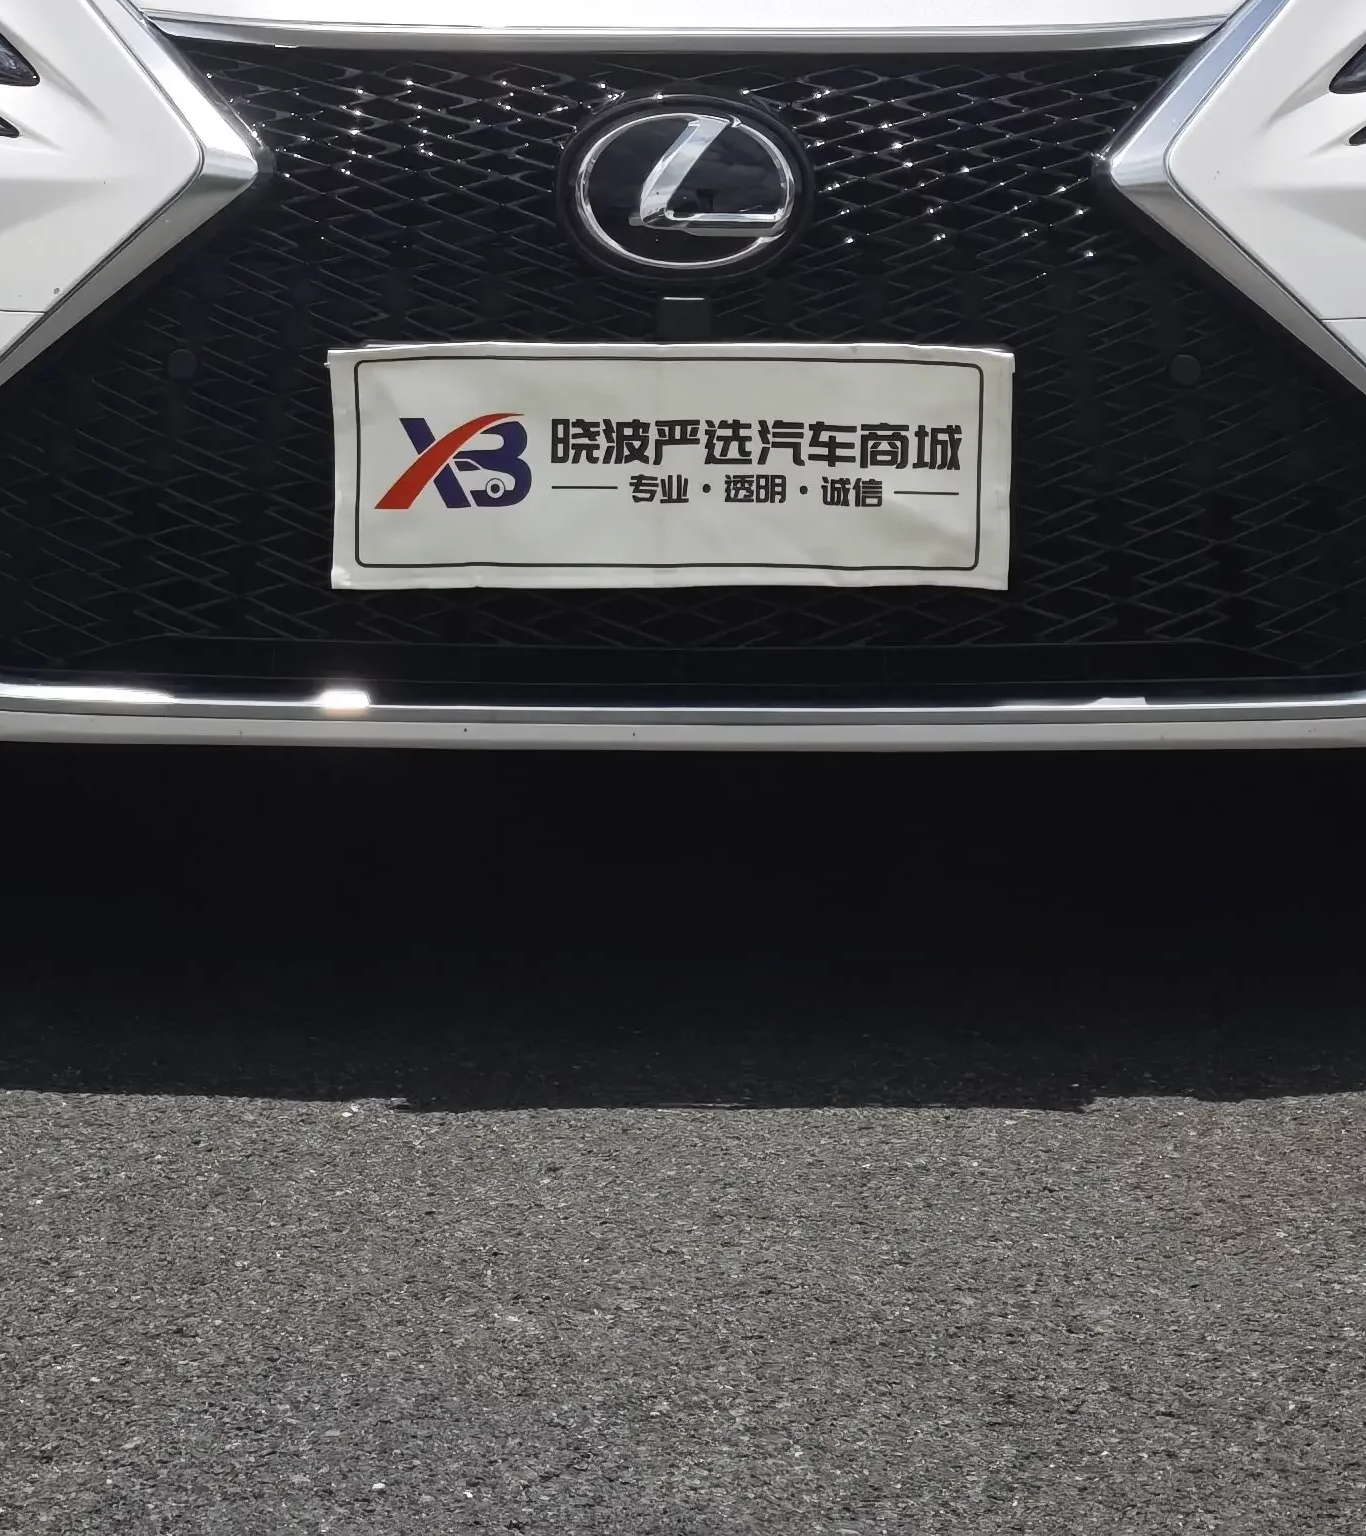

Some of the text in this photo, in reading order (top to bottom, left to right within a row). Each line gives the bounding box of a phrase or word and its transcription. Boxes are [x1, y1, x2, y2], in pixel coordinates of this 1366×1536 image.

[550, 418, 963, 472] 晓波严选汽车商城
